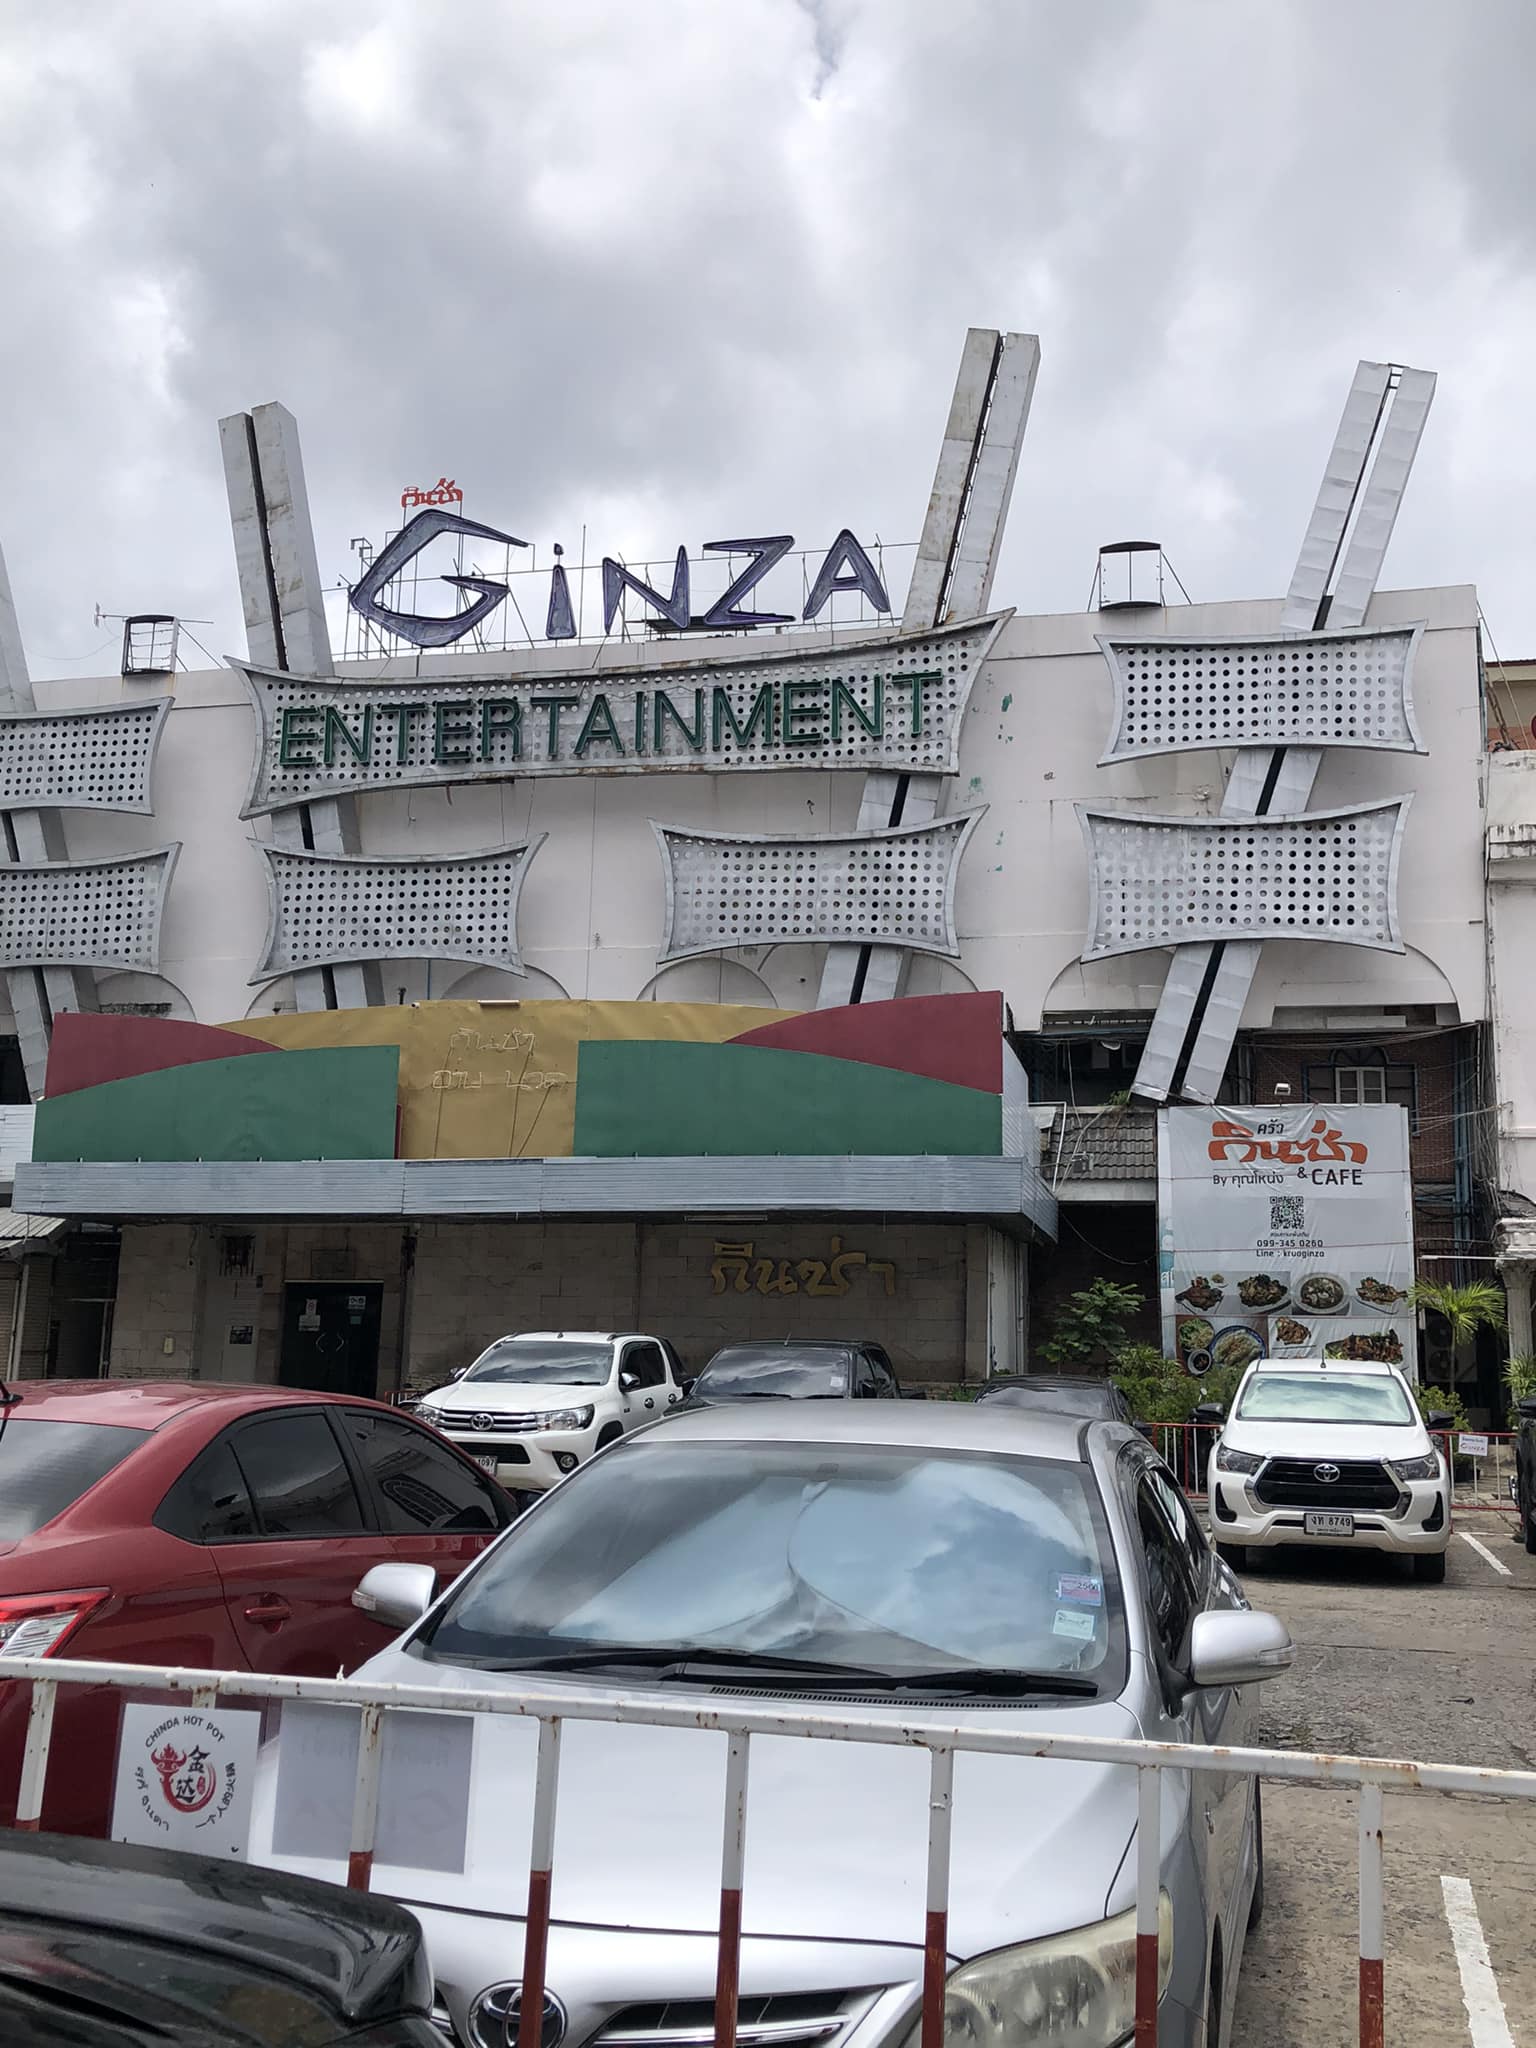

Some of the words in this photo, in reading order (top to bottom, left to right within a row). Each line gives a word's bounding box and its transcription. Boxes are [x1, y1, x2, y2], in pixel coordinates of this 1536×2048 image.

[279, 670, 943, 767] ENTERTAINMENT
[1257, 1118, 1284, 1135] ครัว
[1208, 1120, 1368, 1164] กินซ่า
[1213, 1174, 1227, 1187] By
[1297, 1166, 1308, 1179] &
[1312, 1168, 1363, 1185] CAFE
[1256, 1239, 1296, 1248] 099-345
[1299, 1239, 1324, 1248] 0260
[1256, 1249, 1274, 1257] Line
[1328, 1516, 1351, 1527] 8749
[145, 1717, 180, 1748] CHINDA
[183, 1715, 204, 1730] HOT
[206, 1722, 226, 1743] POT
